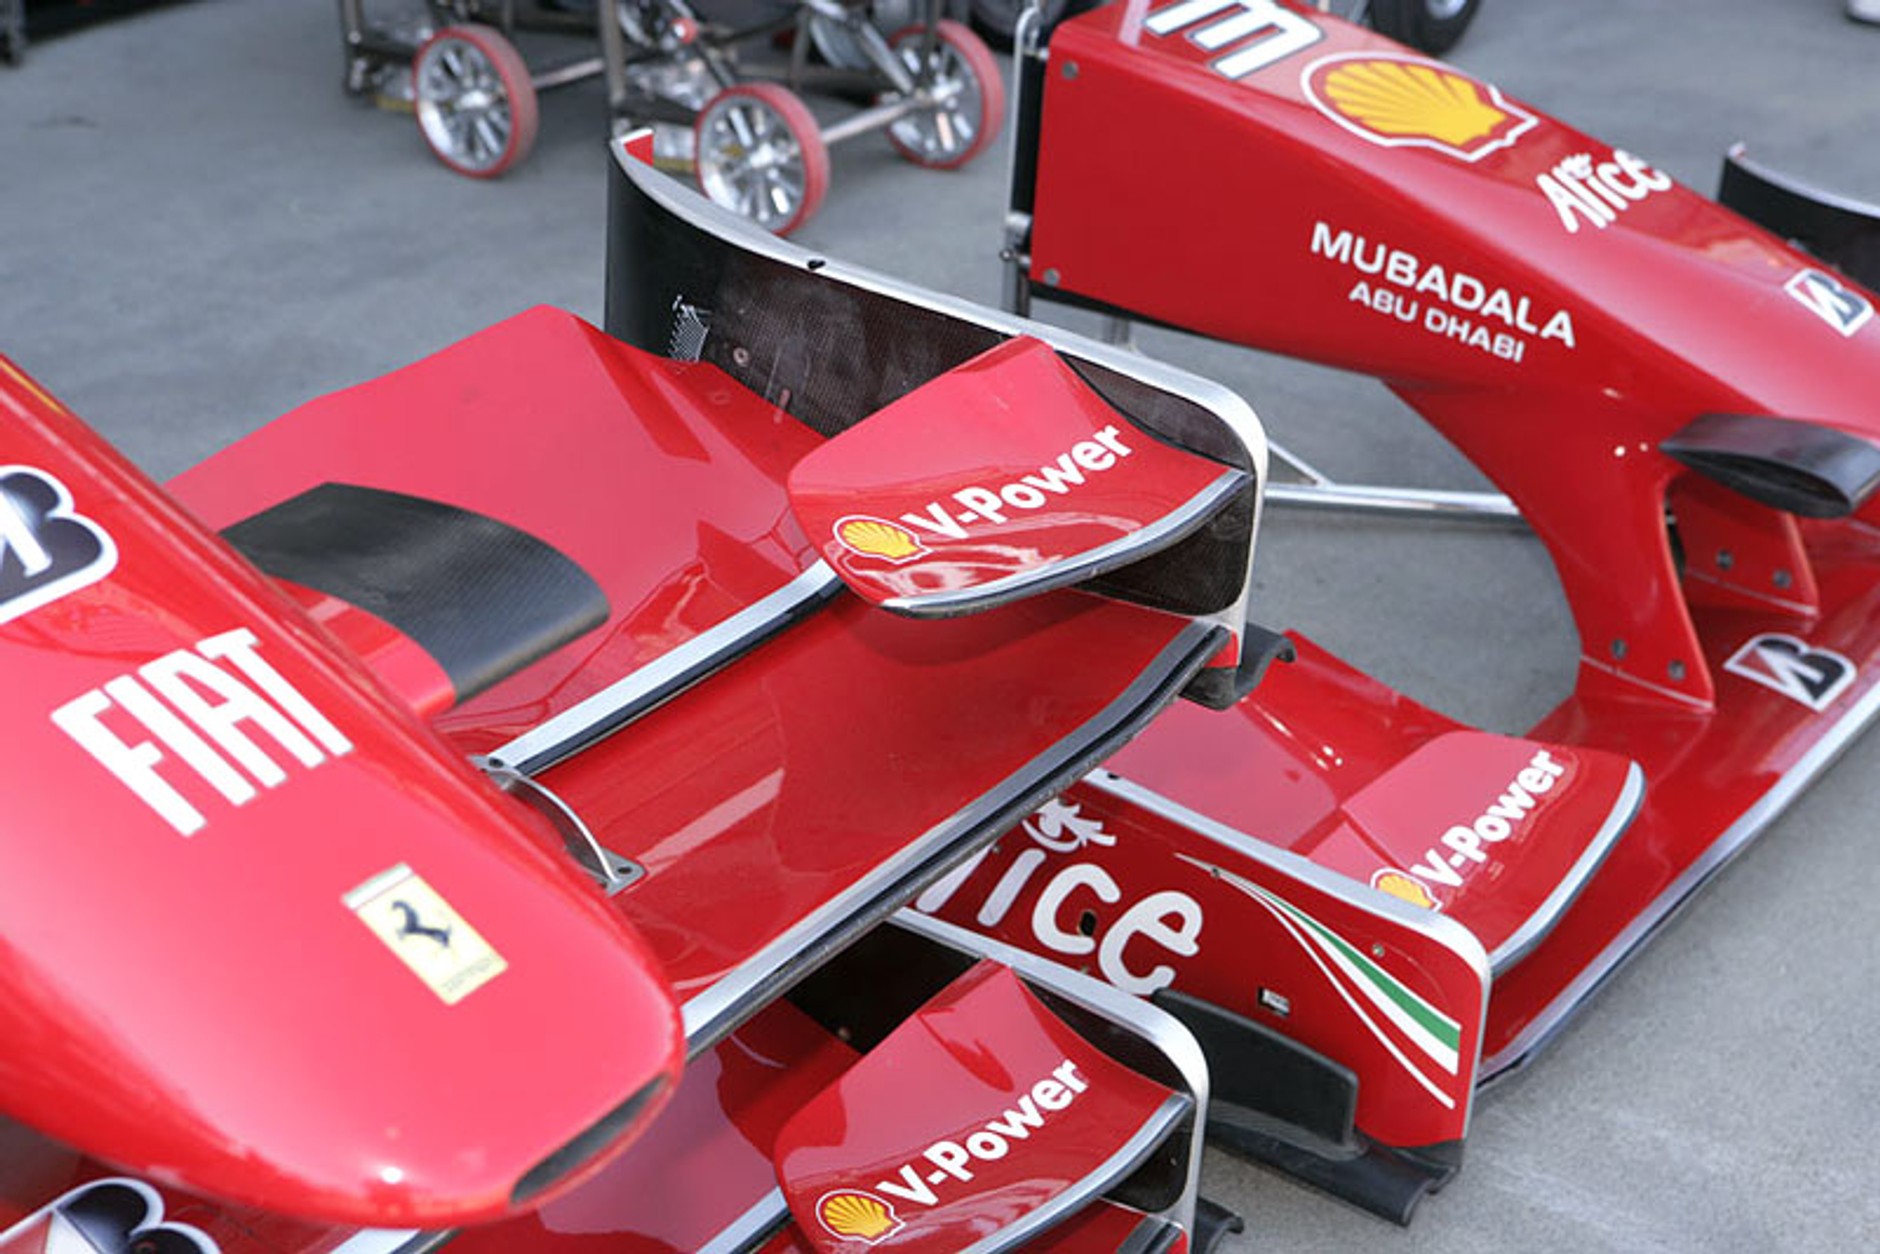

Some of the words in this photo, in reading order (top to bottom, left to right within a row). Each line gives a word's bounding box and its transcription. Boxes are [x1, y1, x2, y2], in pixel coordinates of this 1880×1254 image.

[1536, 149, 1672, 233] Alice
[1310, 221, 1576, 349] MUBADALA
[1348, 281, 1419, 323] ABU
[1424, 306, 1526, 363] DHABI
[900, 424, 1132, 540] V-Power
[50, 627, 354, 837] FIAT
[1409, 749, 1566, 888] V-Power
[875, 1059, 1088, 1206] V-Power
